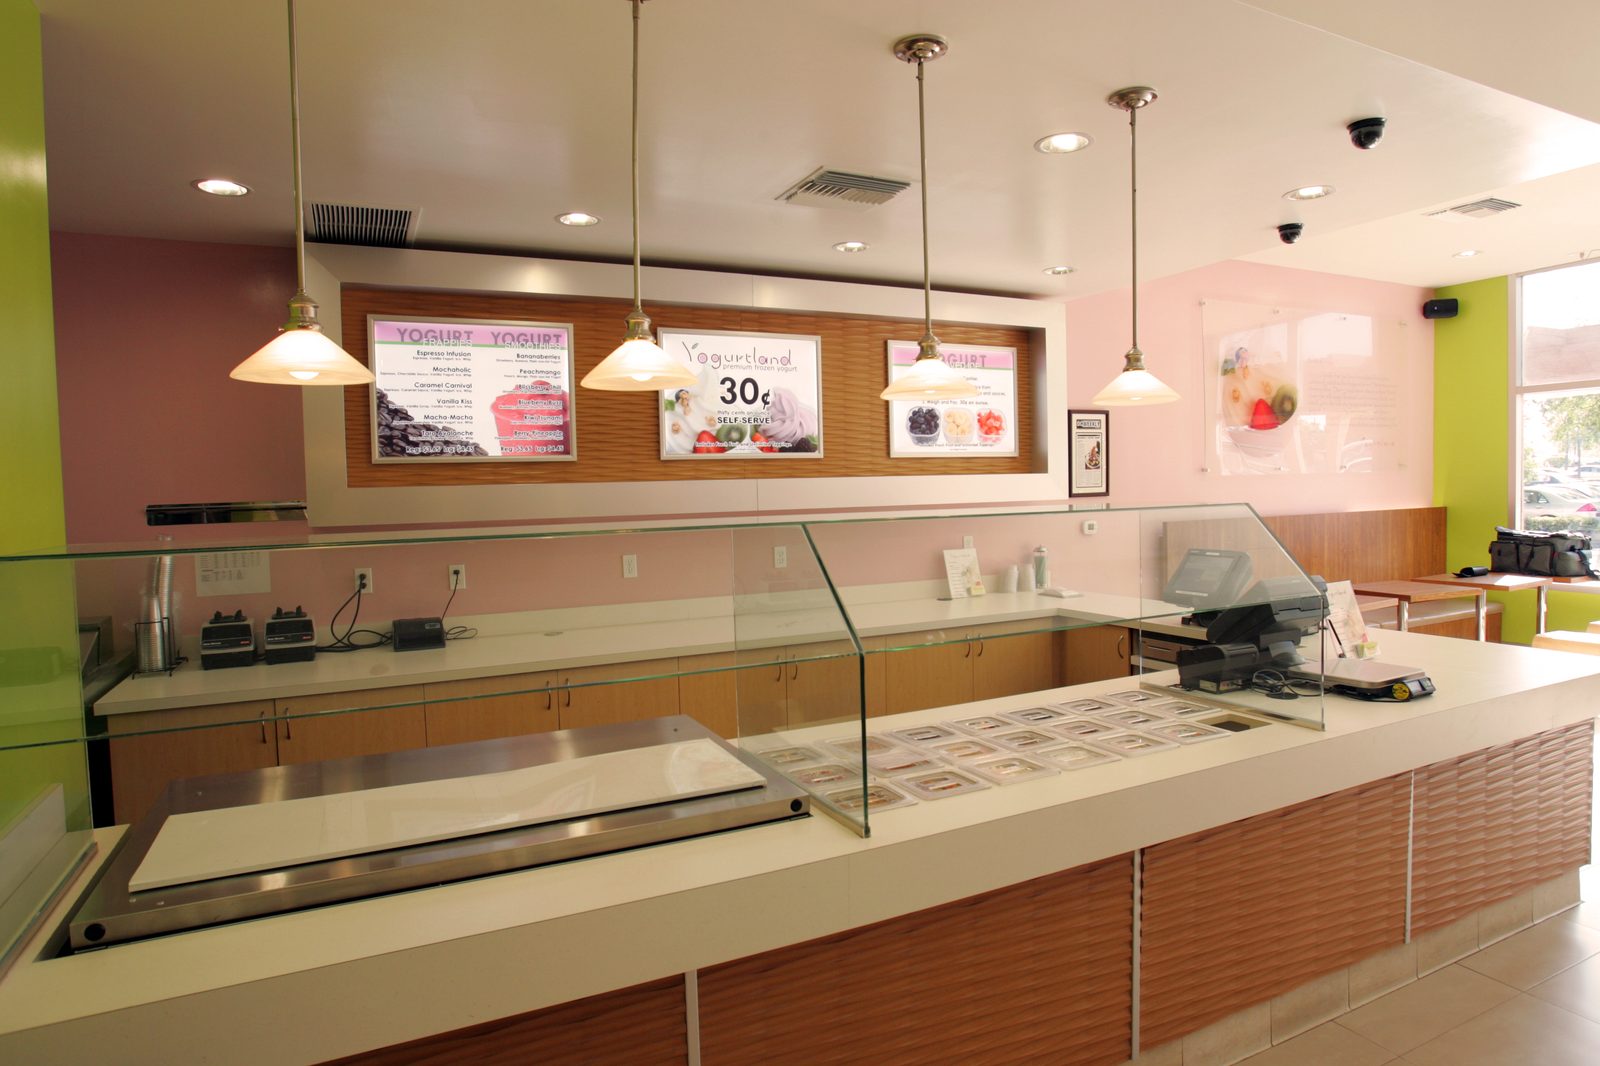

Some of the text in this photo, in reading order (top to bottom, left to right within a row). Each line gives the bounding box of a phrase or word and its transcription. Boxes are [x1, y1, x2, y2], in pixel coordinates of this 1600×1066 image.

[396, 328, 473, 344] YOGURT
[490, 331, 562, 346] YOGURT
[682, 341, 792, 369] Yogurtland
[519, 368, 561, 376] Peachmango
[777, 365, 798, 373] yogurt
[720, 376, 771, 410] 30¢
[717, 416, 771, 424] SELF-SERVE
